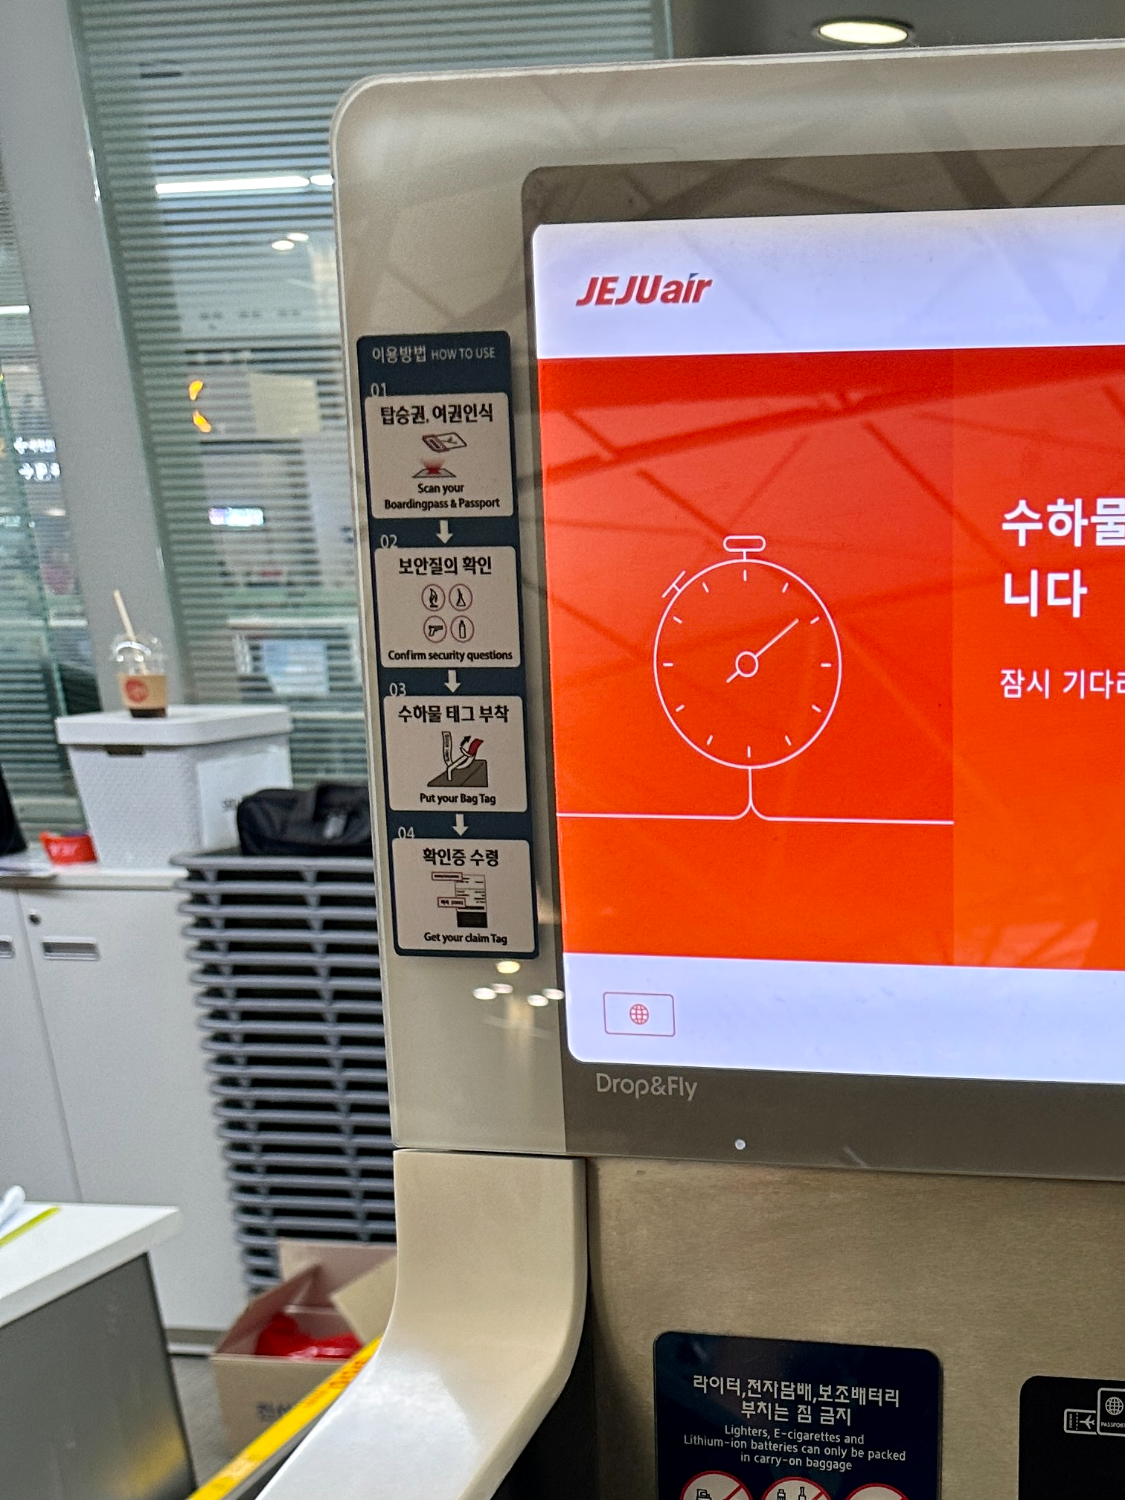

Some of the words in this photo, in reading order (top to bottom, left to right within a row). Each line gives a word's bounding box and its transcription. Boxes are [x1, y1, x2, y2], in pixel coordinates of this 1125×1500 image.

[575, 272, 713, 307] JEJUair
[372, 345, 427, 364] 이용방법
[431, 349, 457, 361] HOW
[459, 348, 474, 360] TO
[475, 346, 496, 359] USE
[371, 382, 388, 397] 01
[380, 405, 430, 424] 탑승권,
[431, 403, 494, 424] 여권인식
[417, 482, 441, 494] Scan
[442, 482, 465, 496] your
[384, 498, 450, 511] Boardingpass
[450, 498, 457, 508] &
[458, 497, 501, 510] Passport
[380, 534, 398, 549] 02
[398, 556, 459, 576] 보안질의
[462, 555, 493, 576] 확인
[1003, 569, 1088, 618] 니다
[388, 649, 427, 661] Confirm
[428, 650, 465, 663] security
[466, 650, 513, 663] questions
[389, 682, 407, 697] 03
[1000, 668, 1052, 700] 잠시
[398, 704, 443, 723] 수하물
[446, 704, 476, 723] 태그
[478, 704, 510, 723] 부착
[419, 792, 434, 804] Put
[434, 793, 459, 806] your
[460, 793, 479, 806] Bag
[479, 793, 497, 806] Tag
[397, 826, 416, 840] 04
[422, 848, 468, 867] 확인증
[470, 849, 499, 867] 수령
[424, 931, 441, 944] Get
[442, 932, 463, 946] your
[464, 931, 490, 944] claim
[491, 933, 508, 946] Tag
[595, 1072, 698, 1102] Drop&Fly
[740, 1400, 790, 1422] 부치는
[796, 1404, 813, 1424] 짐
[819, 1406, 852, 1427] 금지
[724, 1424, 772, 1440] Lighters,
[773, 1427, 842, 1445] E-cigarettes
[843, 1433, 865, 1445] and
[683, 1434, 748, 1450] Lithium-ion
[750, 1438, 799, 1453] batteries
[801, 1443, 821, 1455] can
[824, 1444, 848, 1459] only
[851, 1447, 865, 1458] be
[867, 1448, 906, 1462] packed
[740, 1452, 751, 1462] in
[753, 1454, 803, 1468] carry-on
[805, 1457, 853, 1473] baggage
